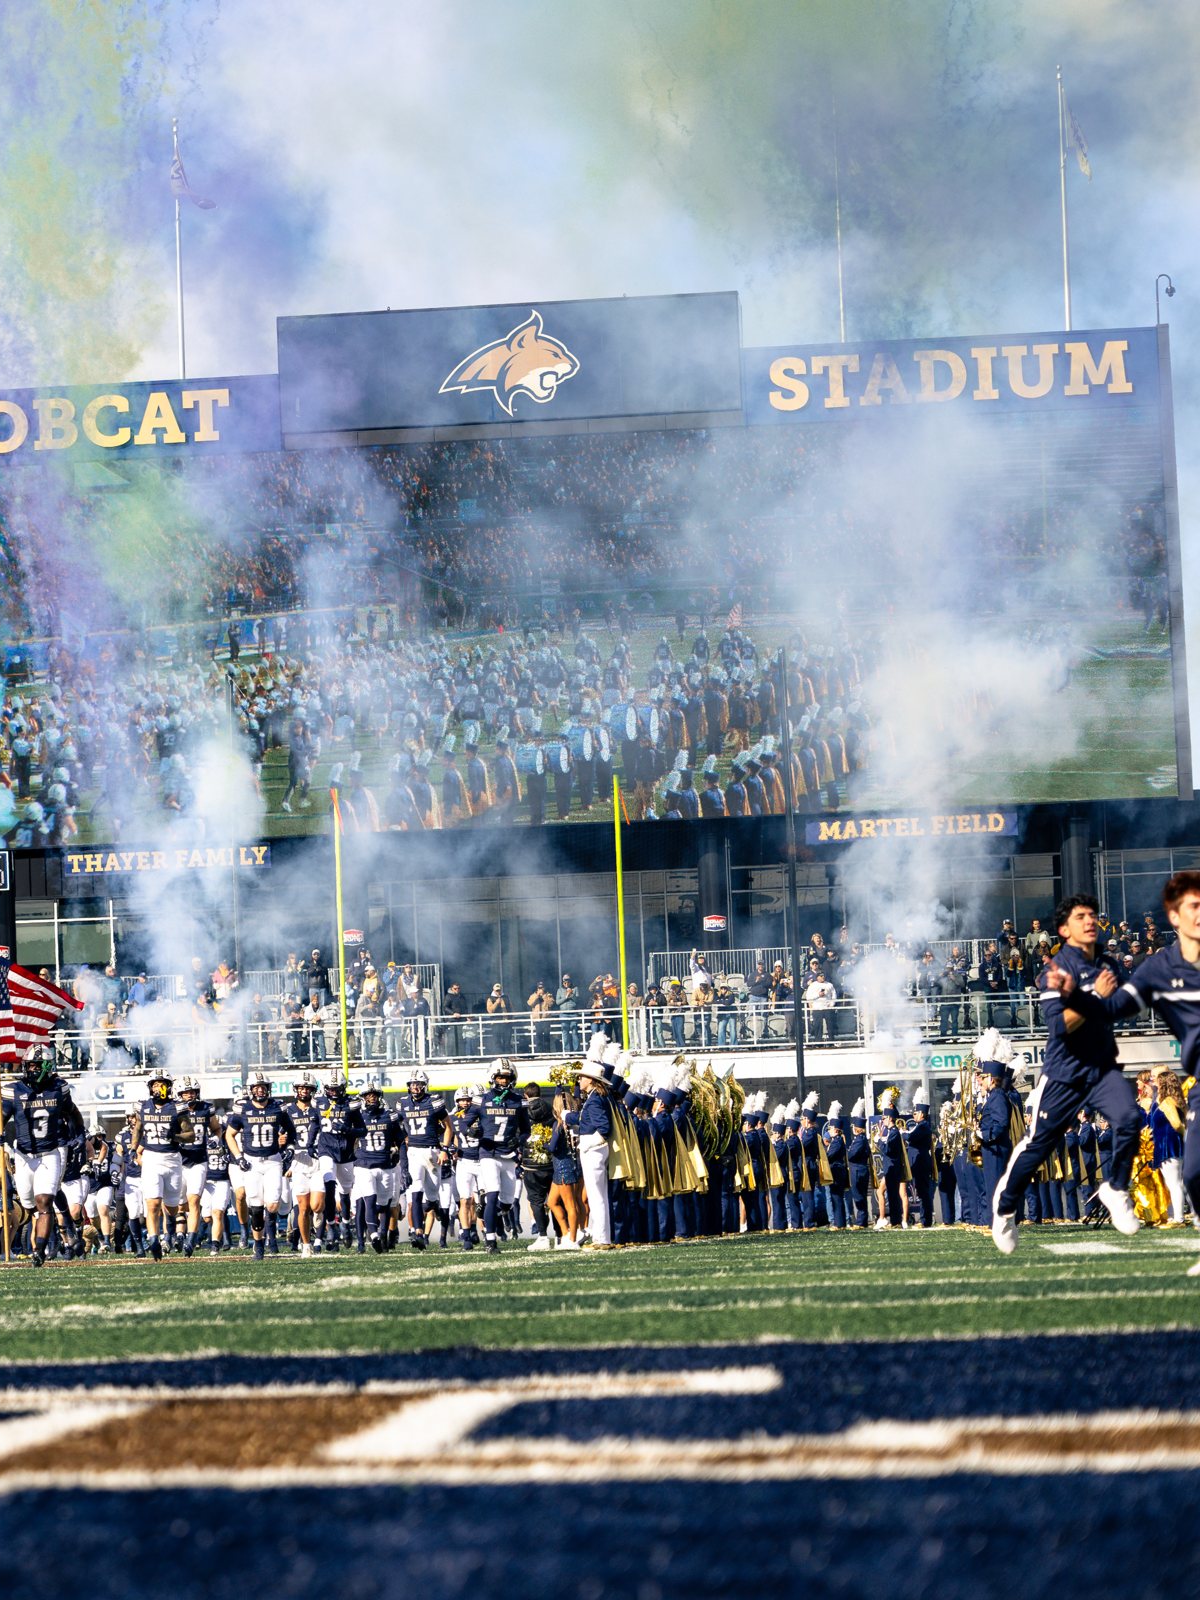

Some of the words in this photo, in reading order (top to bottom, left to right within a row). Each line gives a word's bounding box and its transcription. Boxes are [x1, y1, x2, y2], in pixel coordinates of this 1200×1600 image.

[768, 340, 1133, 412] STADIUM
[818, 818, 925, 841] MARTEL
[931, 813, 1005, 836] FIELD
[67, 850, 169, 874] THAYER
[175, 846, 268, 869] FAMILY
[895, 1048, 973, 1070] Bozem
[31, 1108, 51, 1139] 3
[250, 1124, 274, 1148] 10
[407, 1117, 428, 1136] 17
[493, 1116, 509, 1142] 7
